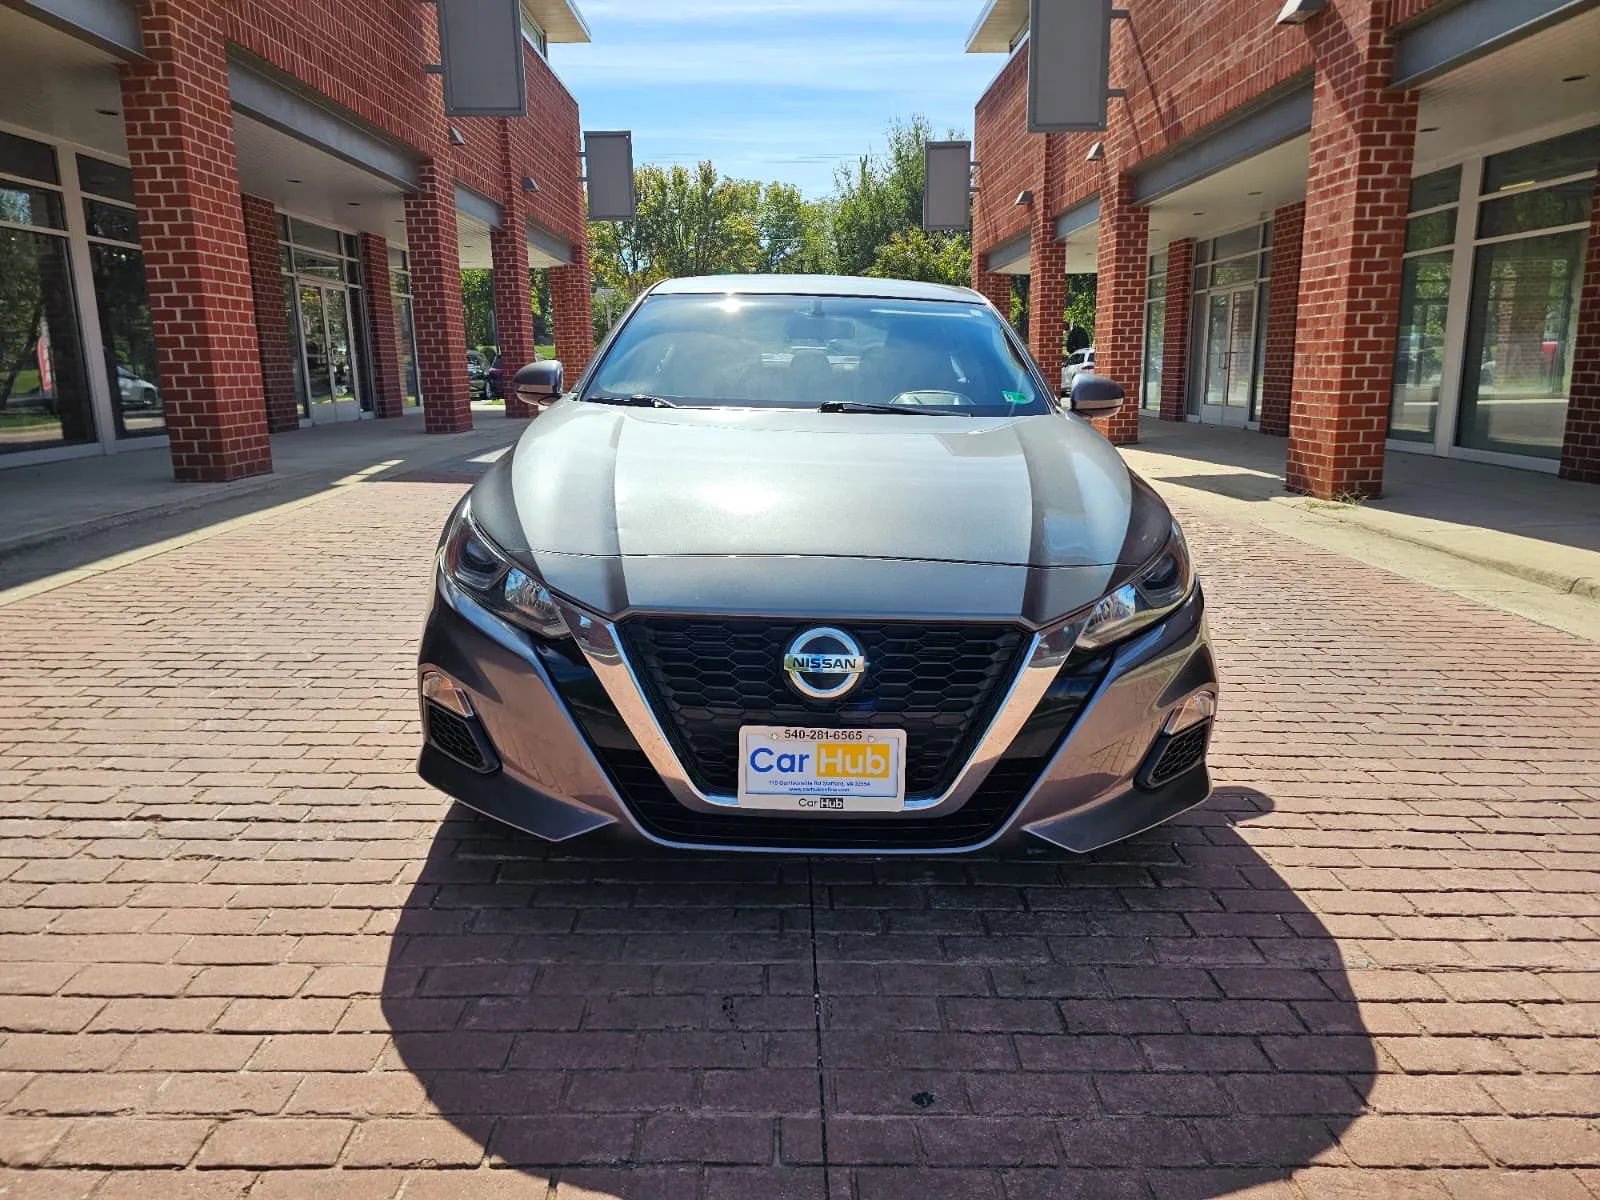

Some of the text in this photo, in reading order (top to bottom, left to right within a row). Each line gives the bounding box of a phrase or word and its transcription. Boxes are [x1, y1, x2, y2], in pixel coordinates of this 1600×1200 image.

[793, 657, 856, 668] NISSAN
[784, 729, 863, 741] 540-281-6565
[750, 747, 887, 775] Car Hub
[798, 798, 844, 809] Car Hub
